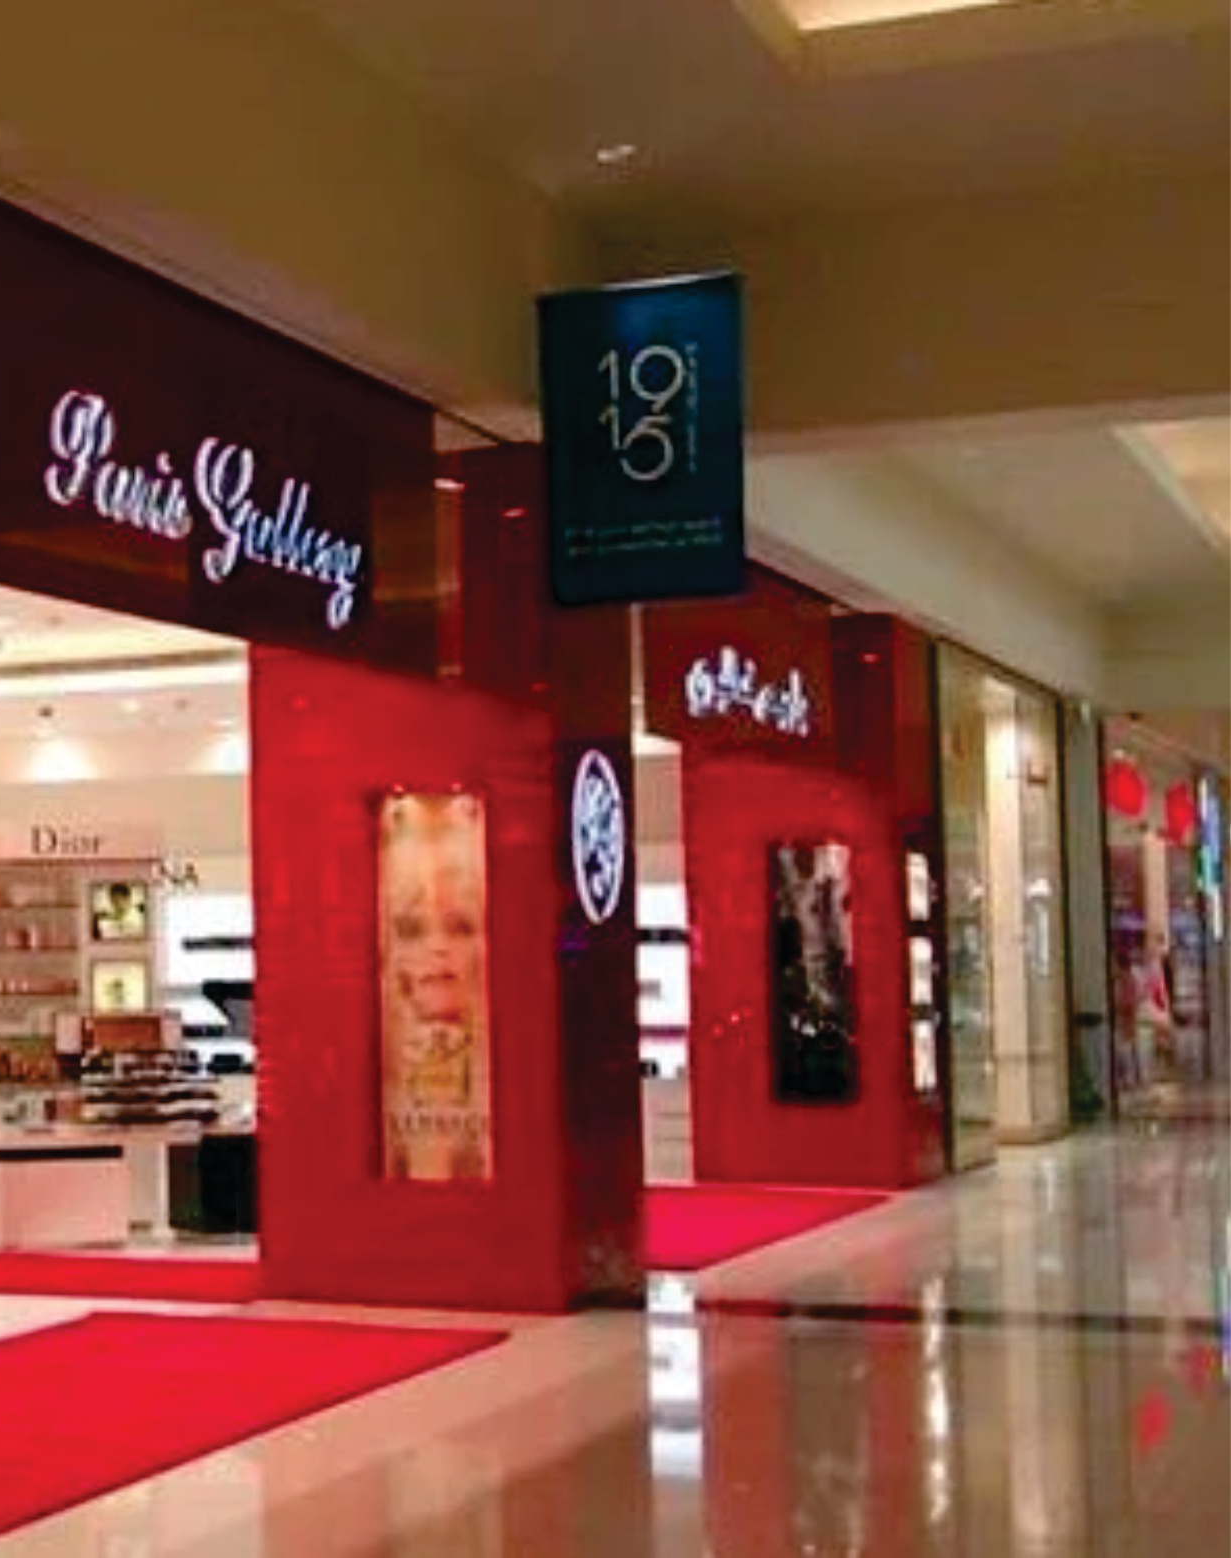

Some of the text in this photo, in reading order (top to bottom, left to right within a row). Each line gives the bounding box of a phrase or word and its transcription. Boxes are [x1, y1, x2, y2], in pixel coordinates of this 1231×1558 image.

[44, 390, 363, 630] Paris Gallery
[31, 825, 100, 854] Dior
